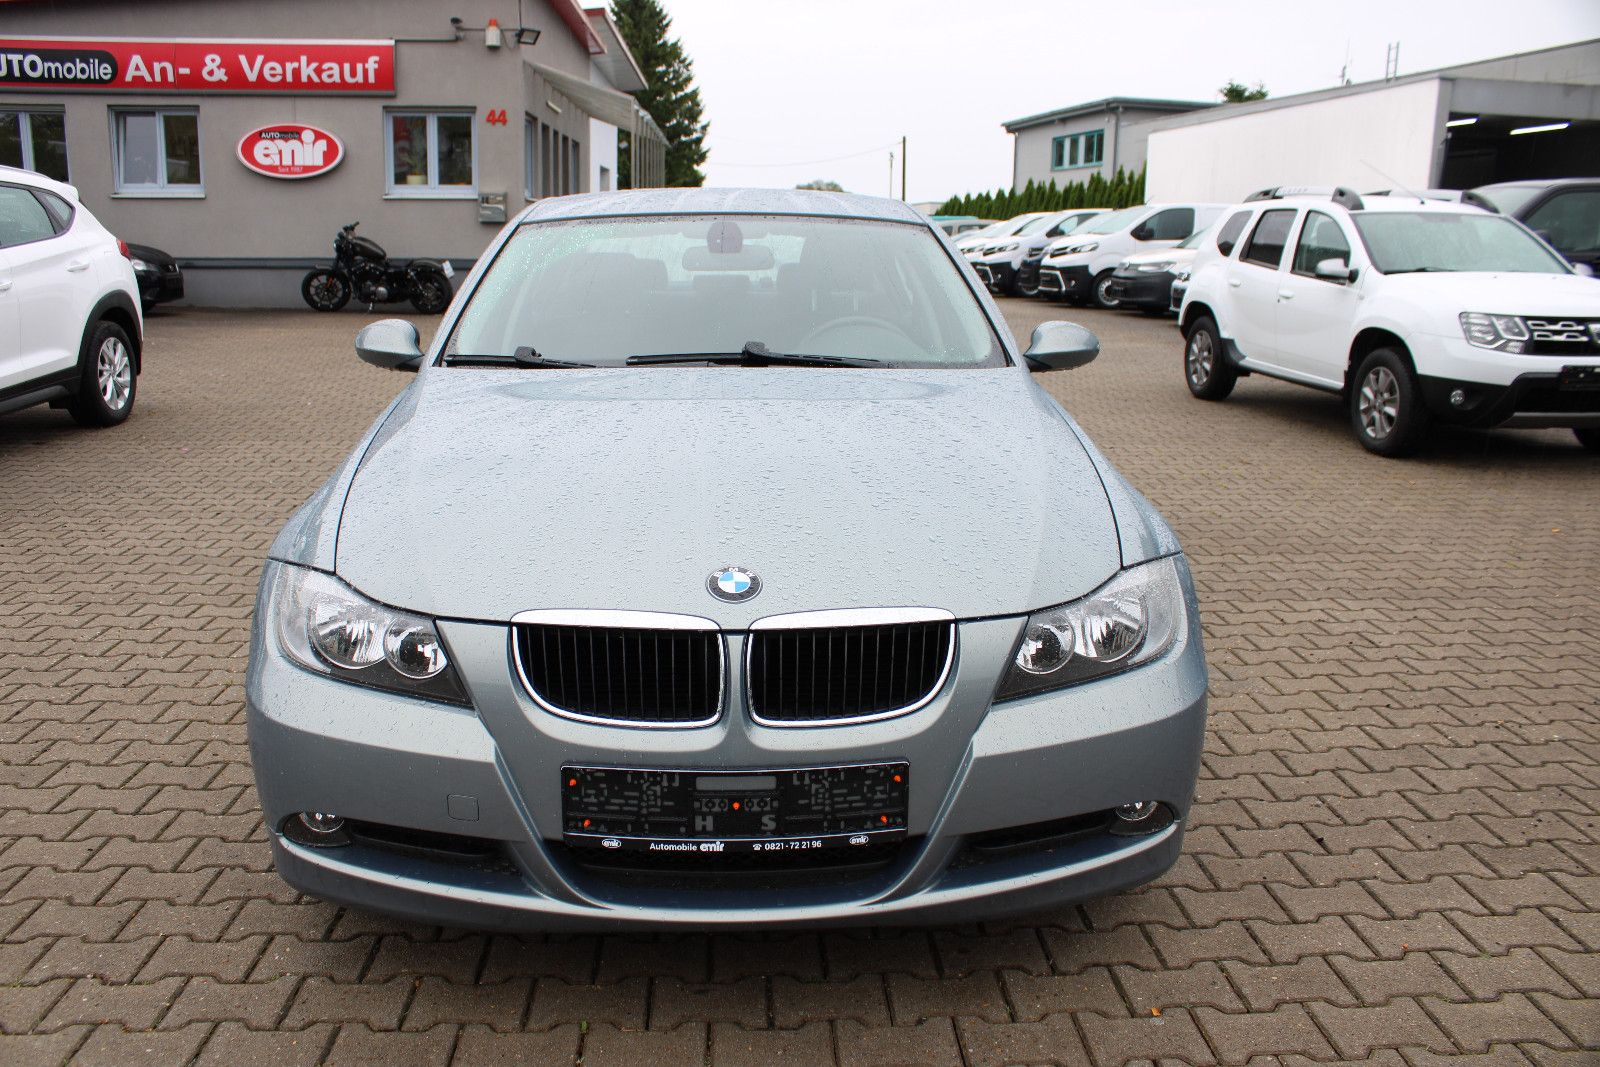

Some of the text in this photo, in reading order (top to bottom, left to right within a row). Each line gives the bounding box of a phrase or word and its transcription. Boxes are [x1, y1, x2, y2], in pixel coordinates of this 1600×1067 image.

[125, 54, 191, 83] An-
[201, 53, 229, 83] &
[238, 55, 380, 84] Verkauf
[486, 109, 507, 126] 44
[253, 129, 328, 167] emir
[650, 841, 725, 852] Automobile emir
[764, 842, 784, 851] 0821
[789, 841, 800, 850] 72
[801, 841, 811, 849] 21
[811, 840, 822, 848] 96
